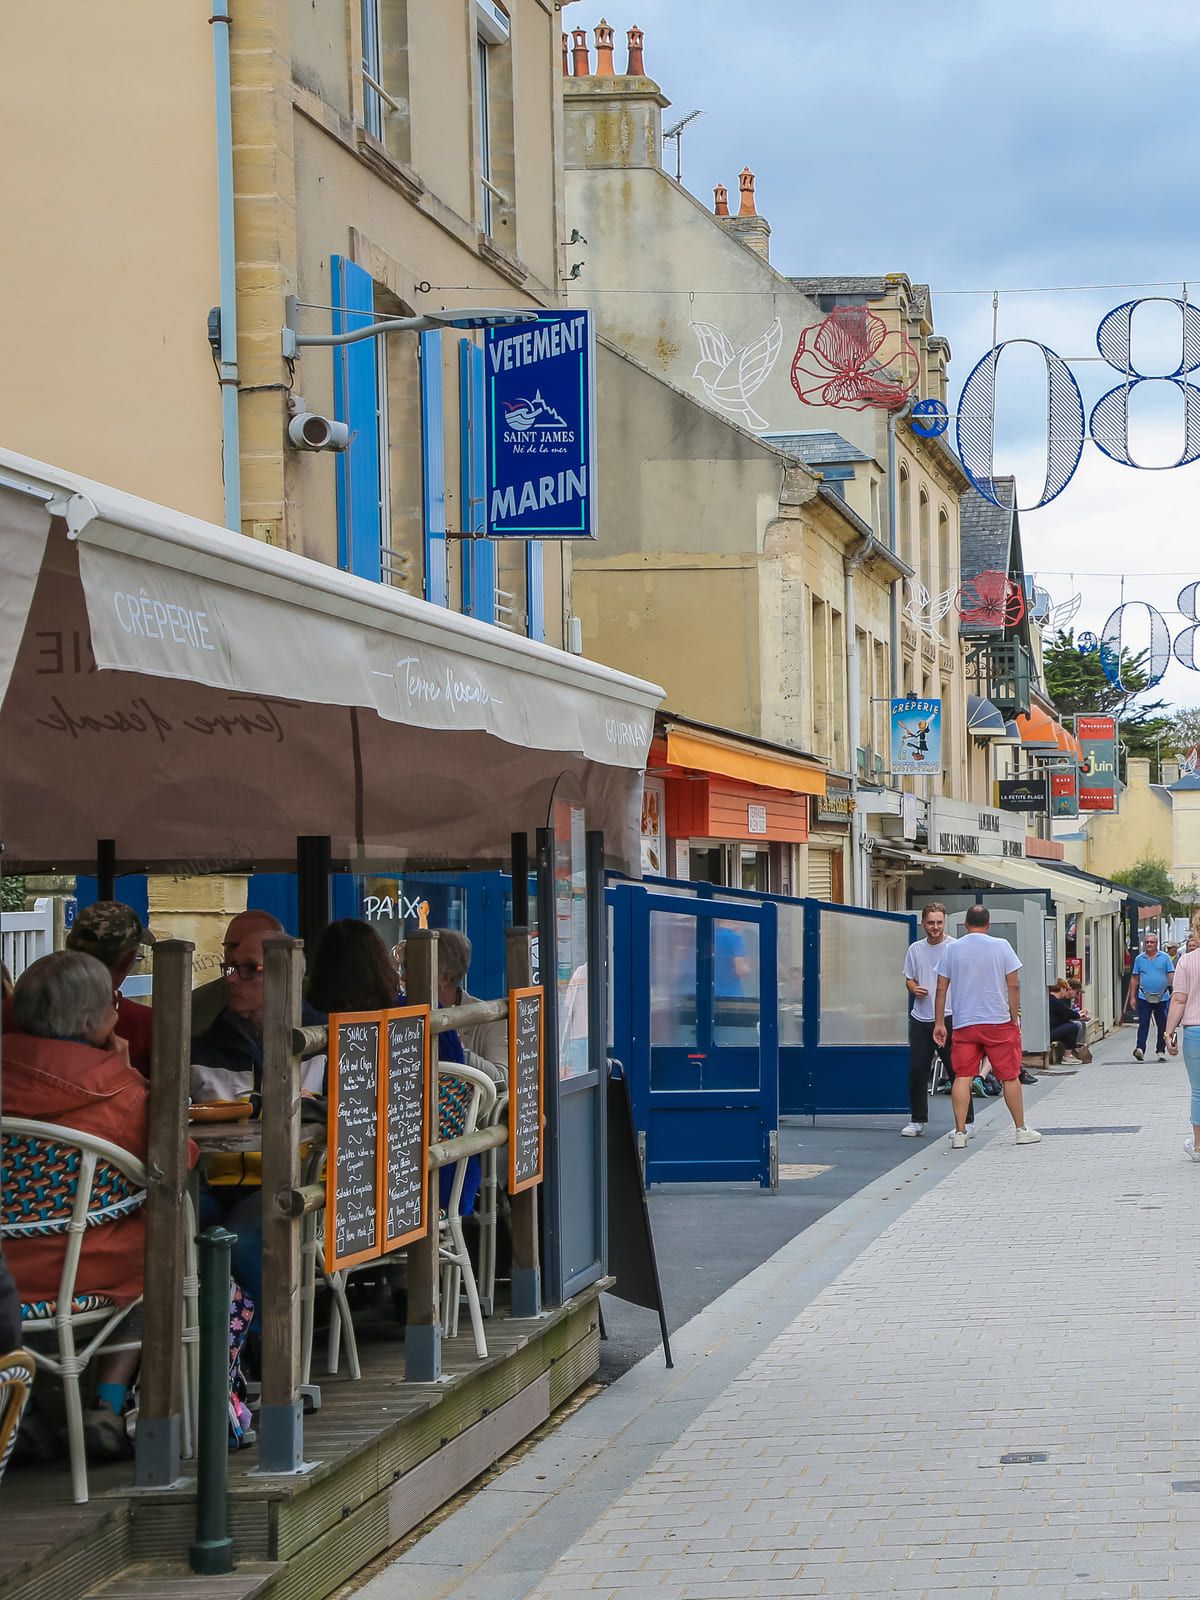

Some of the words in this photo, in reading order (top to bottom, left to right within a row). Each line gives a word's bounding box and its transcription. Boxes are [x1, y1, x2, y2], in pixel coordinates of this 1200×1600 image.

[488, 316, 585, 374] VETEMENT
[503, 431, 537, 442] SAINT
[540, 431, 575, 443] JAMES
[512, 444, 526, 454] Né
[526, 443, 537, 454] de
[539, 443, 550, 453] la
[490, 465, 587, 523] MARIN
[113, 588, 215, 651] CRÊPERIE
[67, 907, 74, 922] 5
[346, 1026, 368, 1043] SNACK
